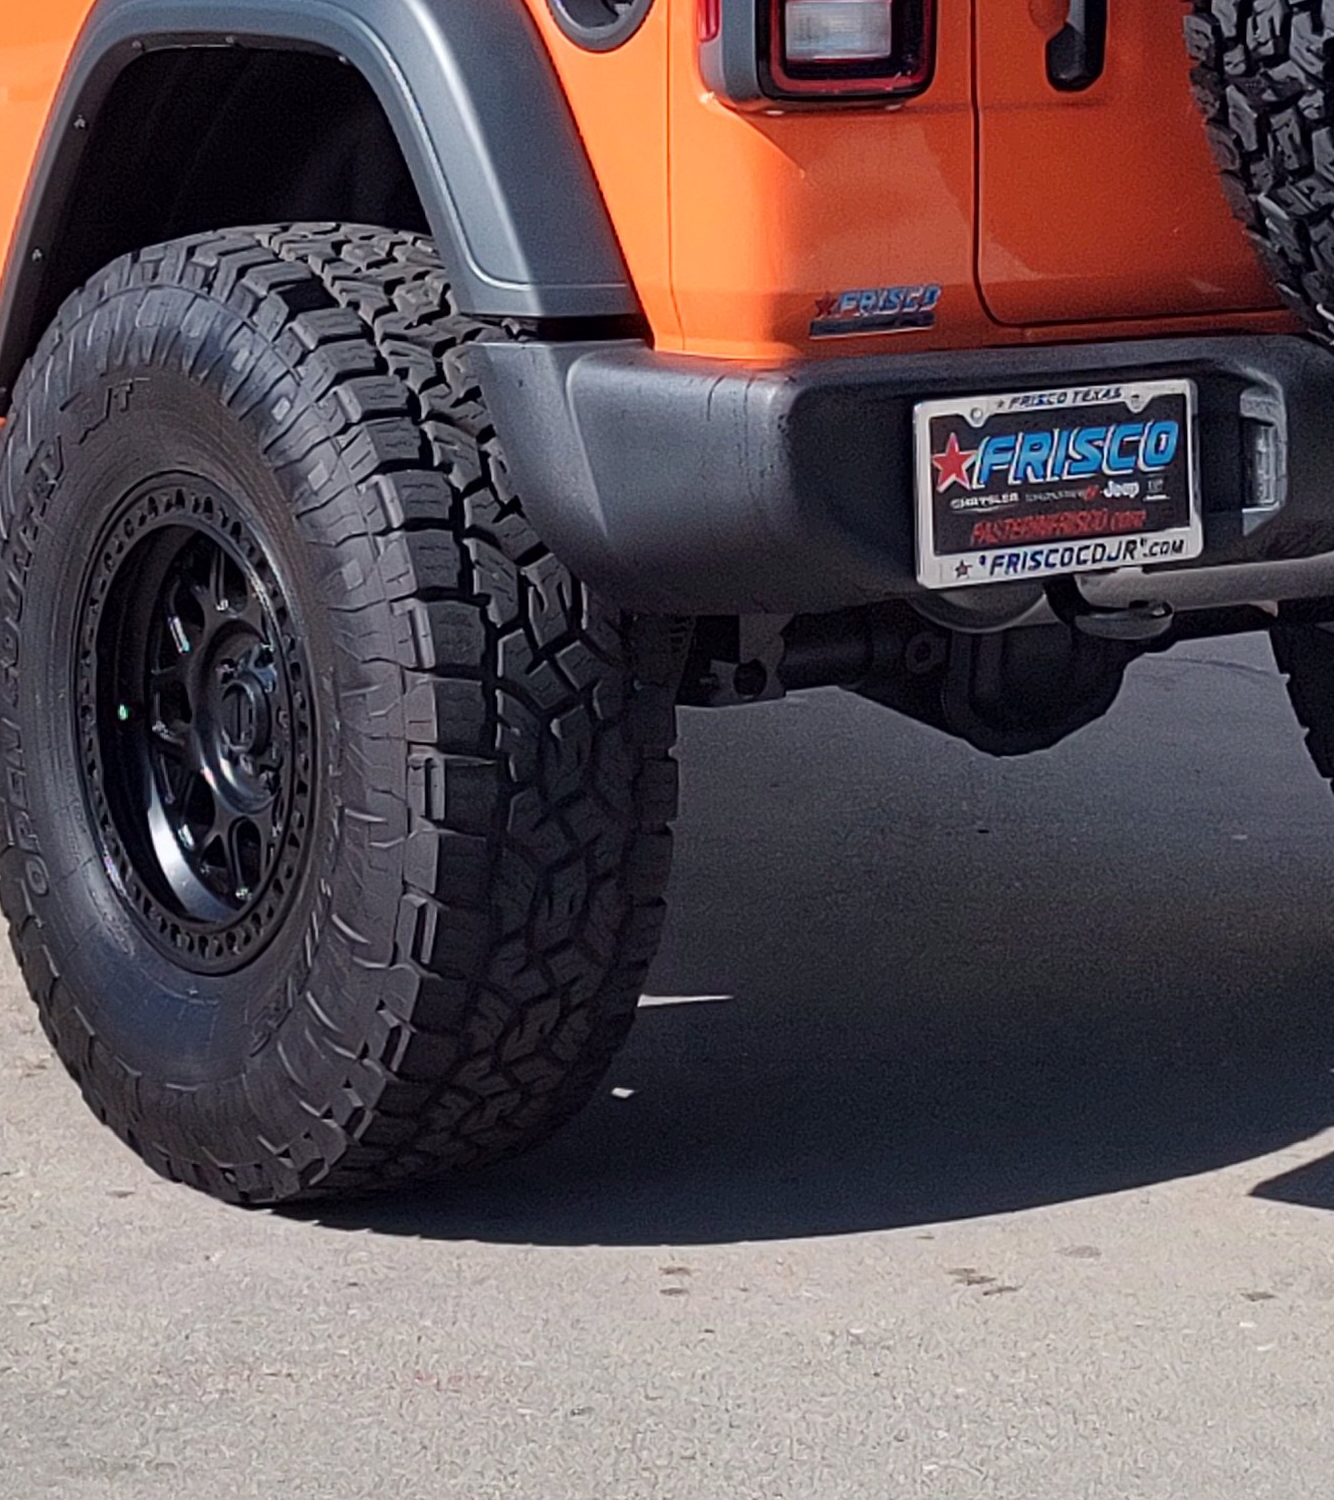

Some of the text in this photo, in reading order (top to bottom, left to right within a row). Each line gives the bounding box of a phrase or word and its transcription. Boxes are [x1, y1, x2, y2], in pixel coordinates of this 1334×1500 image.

[838, 283, 943, 316] FRISCO
[1008, 386, 1123, 410] FRISCO TEXAS
[971, 418, 1180, 490] FRISCO
